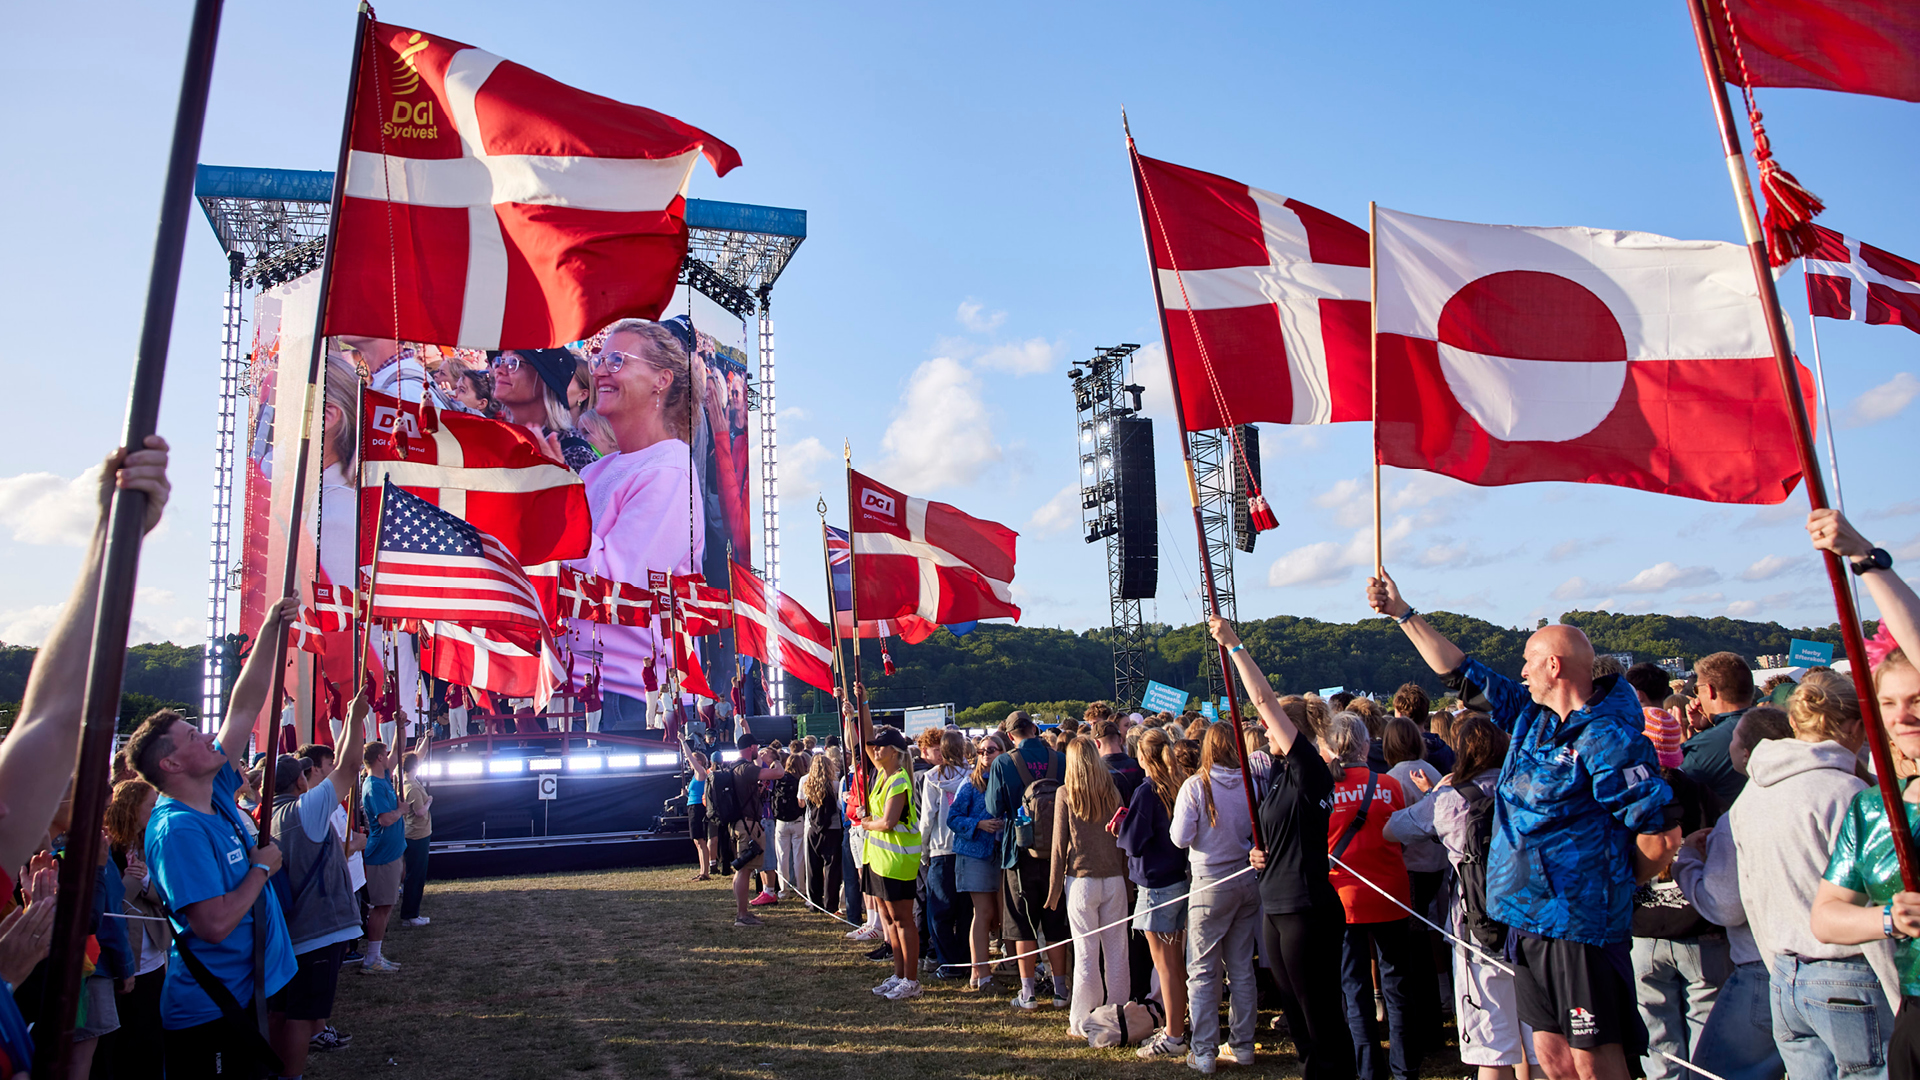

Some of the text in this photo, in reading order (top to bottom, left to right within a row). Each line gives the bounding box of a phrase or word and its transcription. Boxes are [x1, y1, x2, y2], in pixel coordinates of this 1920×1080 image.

[391, 100, 433, 125] DGI
[383, 121, 438, 139] Sydvest
[379, 413, 412, 432] DI
[865, 494, 891, 512] DGI
[1027, 761, 1048, 770] DARE
[541, 777, 555, 795] C
[1334, 784, 1392, 804] rivilig
[1572, 1028, 1594, 1036] CRAFT
